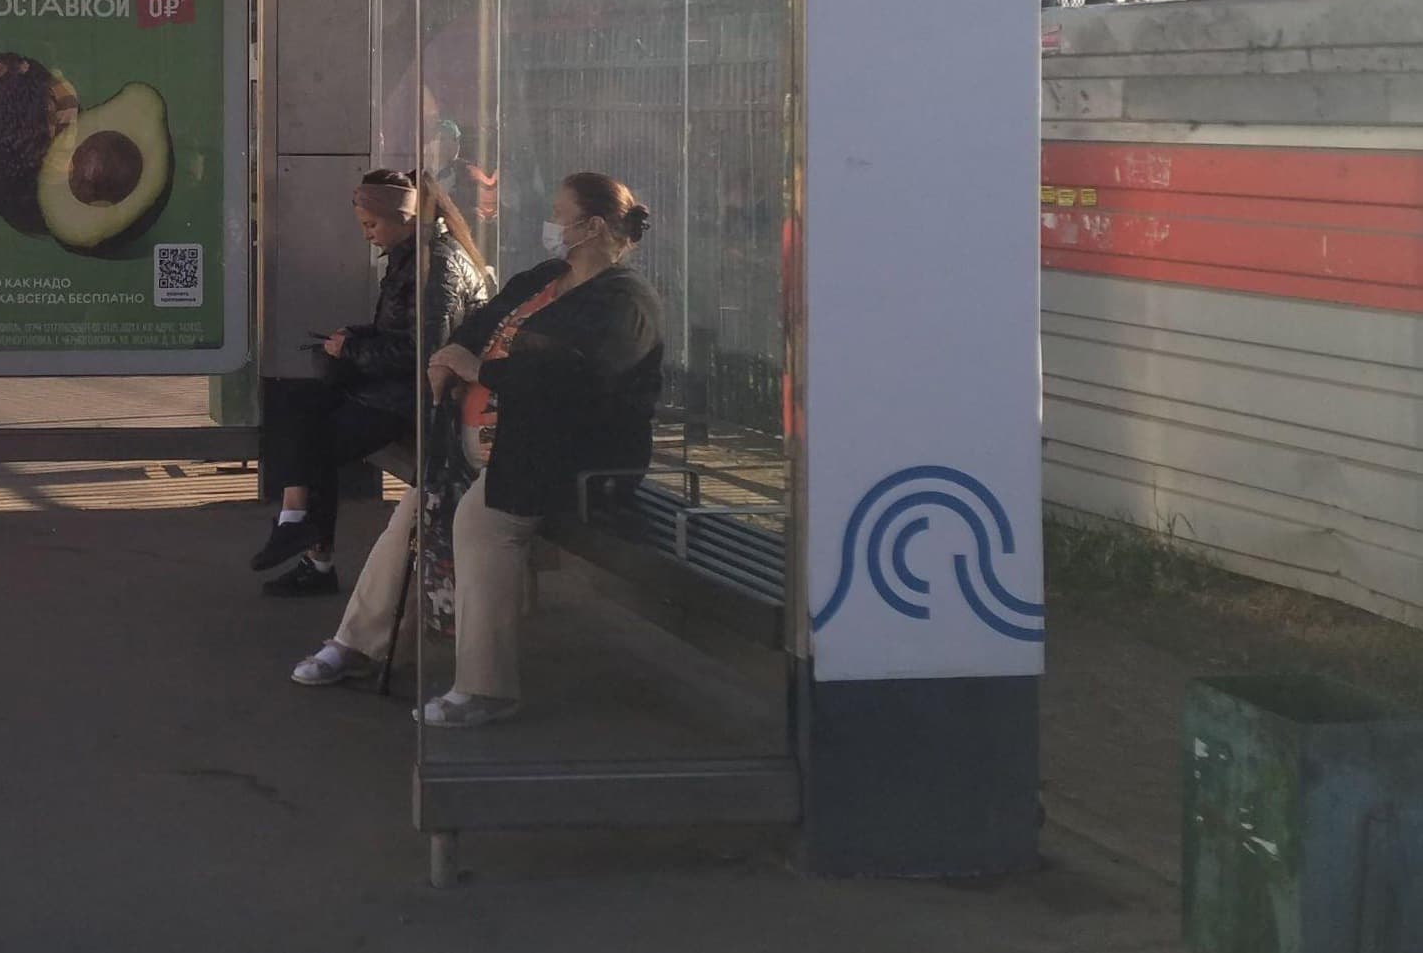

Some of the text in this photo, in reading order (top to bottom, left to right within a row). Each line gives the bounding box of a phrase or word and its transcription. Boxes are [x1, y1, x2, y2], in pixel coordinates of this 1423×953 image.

[4, 277, 32, 289] КАК
[33, 277, 72, 290] НАДО
[17, 292, 65, 305] ВСЕГДА
[68, 292, 145, 305] БЕСПЛАТНО
